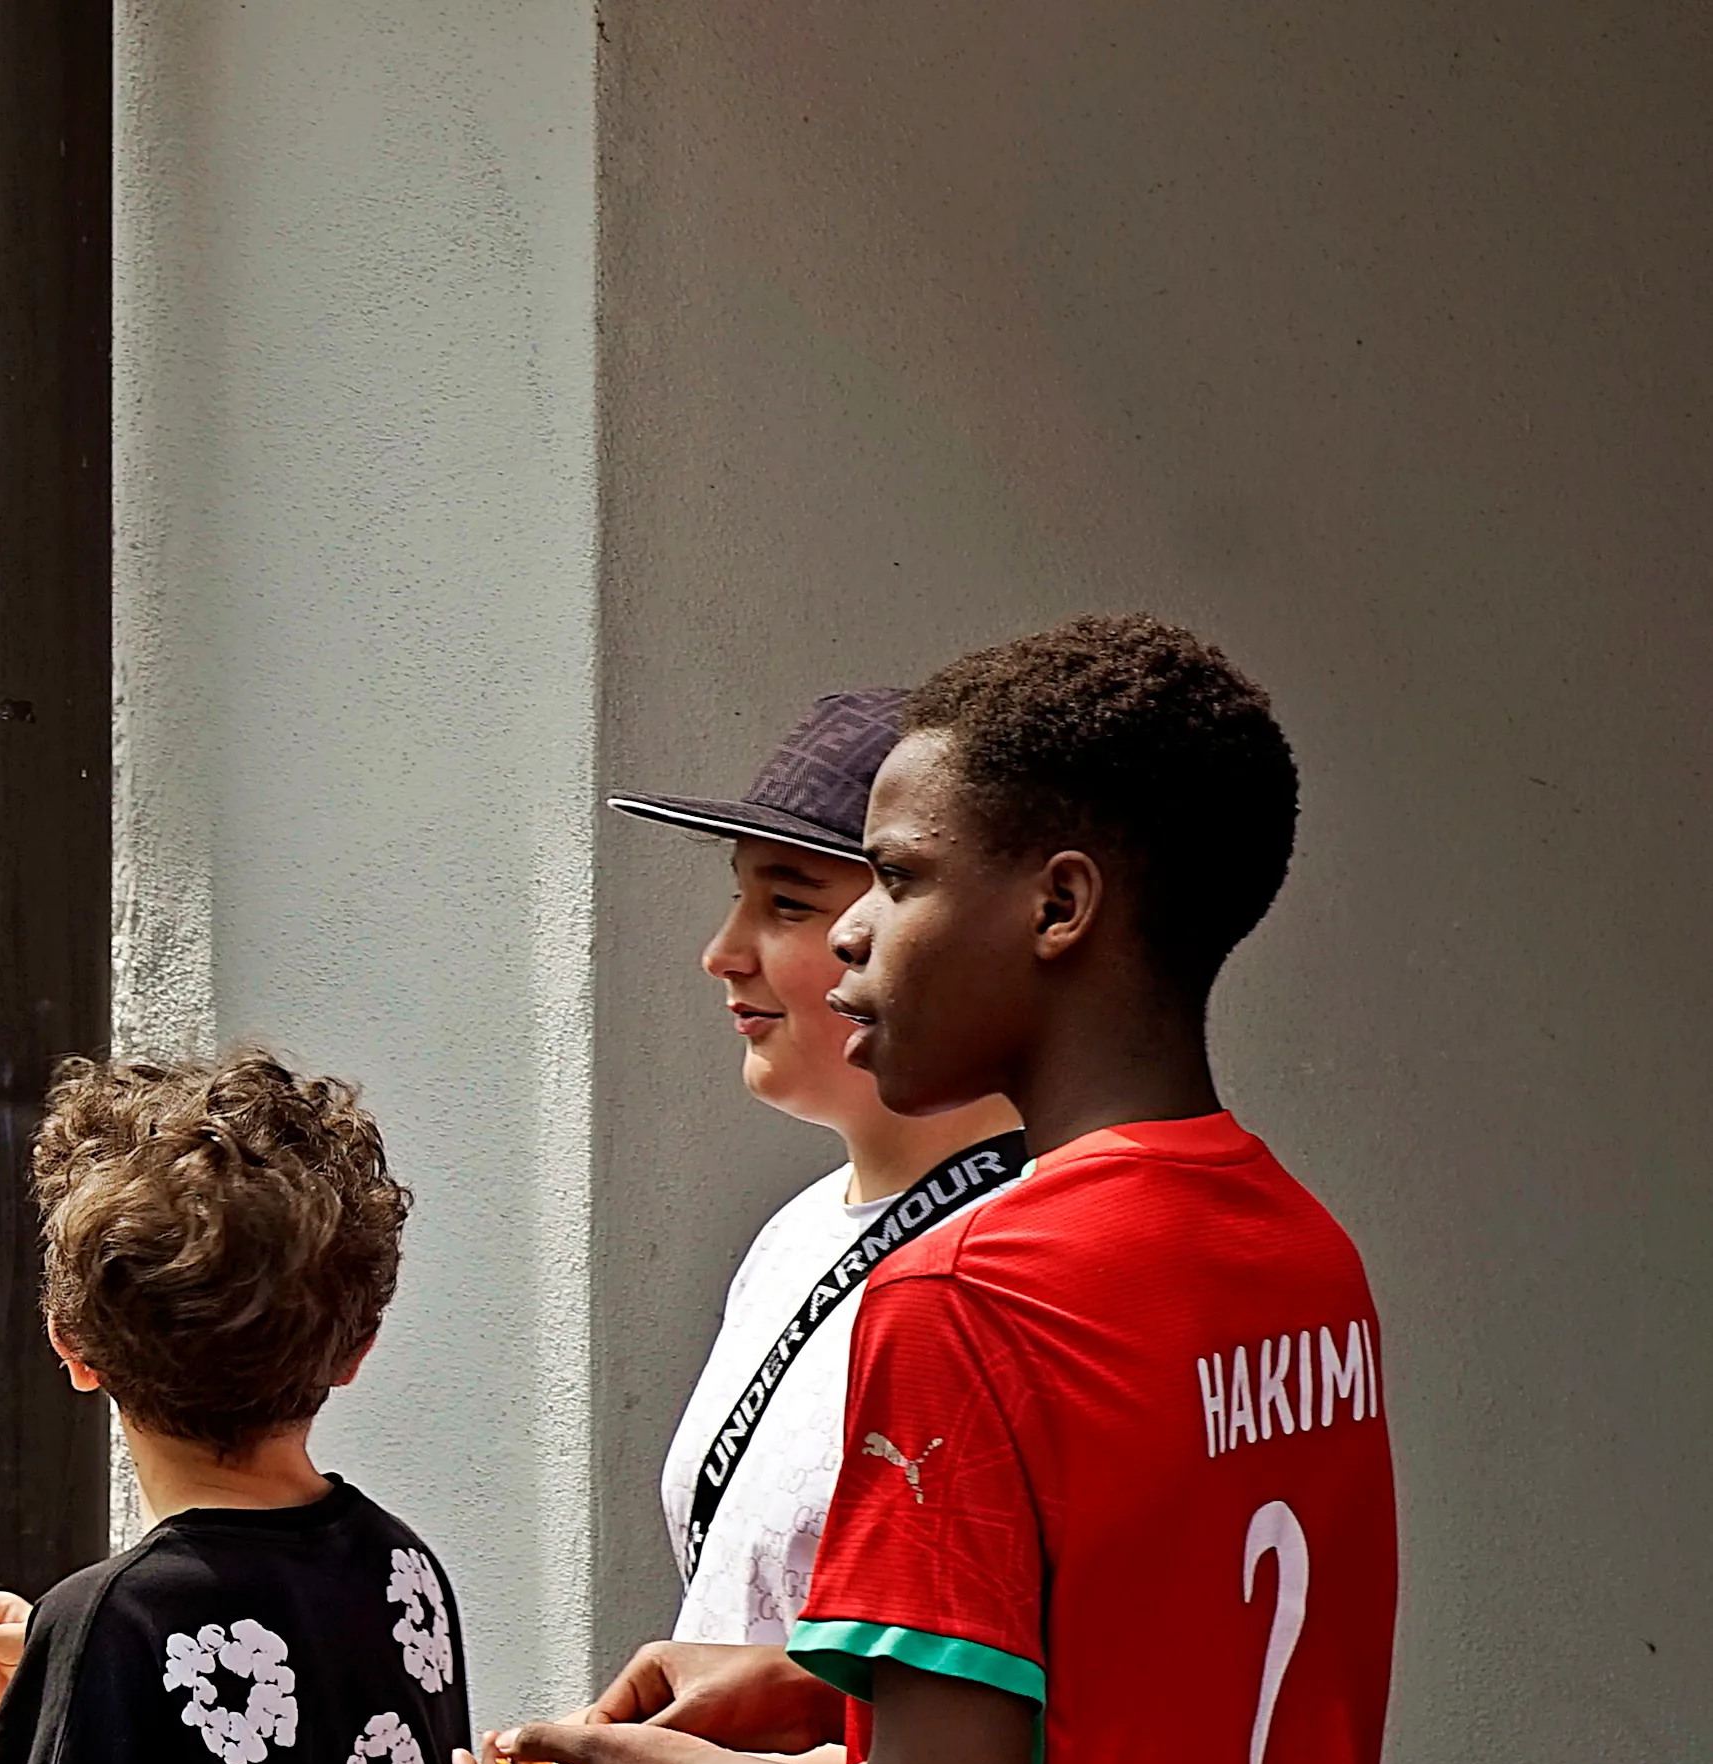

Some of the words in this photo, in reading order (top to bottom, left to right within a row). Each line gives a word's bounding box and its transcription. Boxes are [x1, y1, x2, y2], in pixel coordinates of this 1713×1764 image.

[704, 1320, 805, 1487] UNDER
[809, 1150, 1008, 1322] ARMOUR
[1197, 1319, 1378, 1458] HAKIMI
